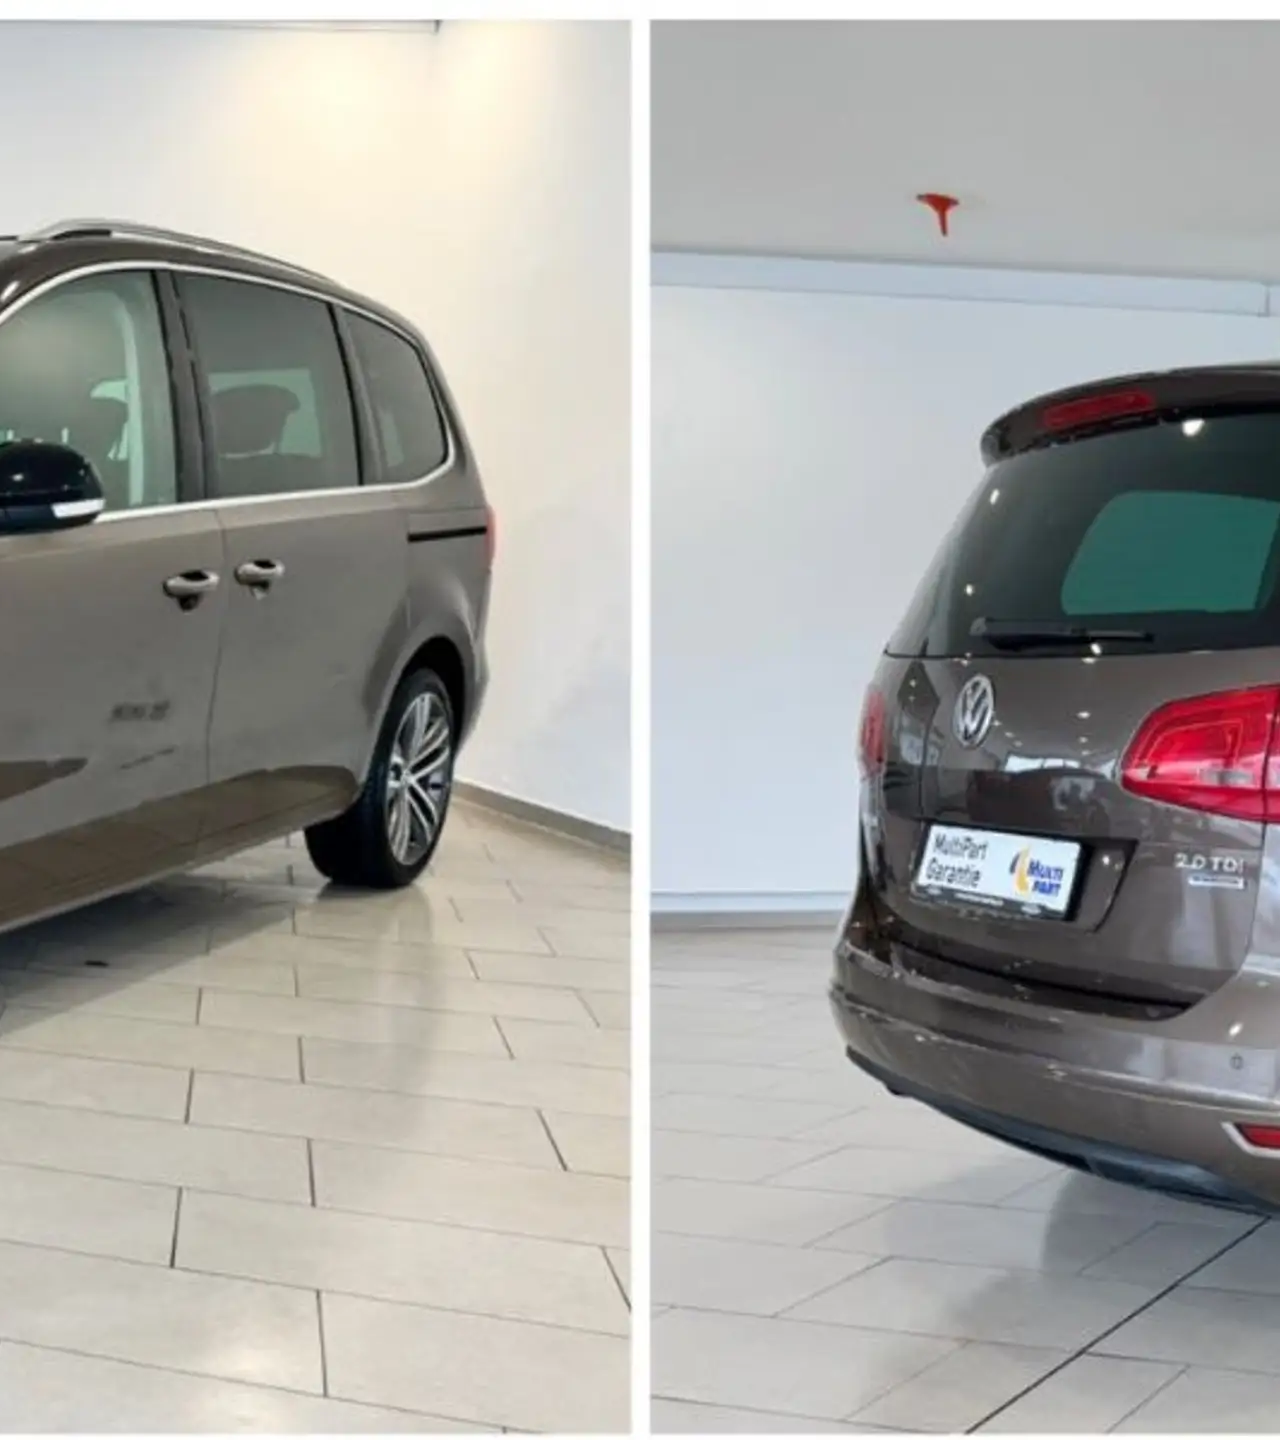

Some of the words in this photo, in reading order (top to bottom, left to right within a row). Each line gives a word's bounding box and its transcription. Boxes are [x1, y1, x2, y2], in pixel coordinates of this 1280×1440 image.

[933, 832, 988, 861] MultiPart
[926, 856, 982, 889] Garantie
[1210, 856, 1244, 873] TDI
[1032, 878, 1062, 897] PART
